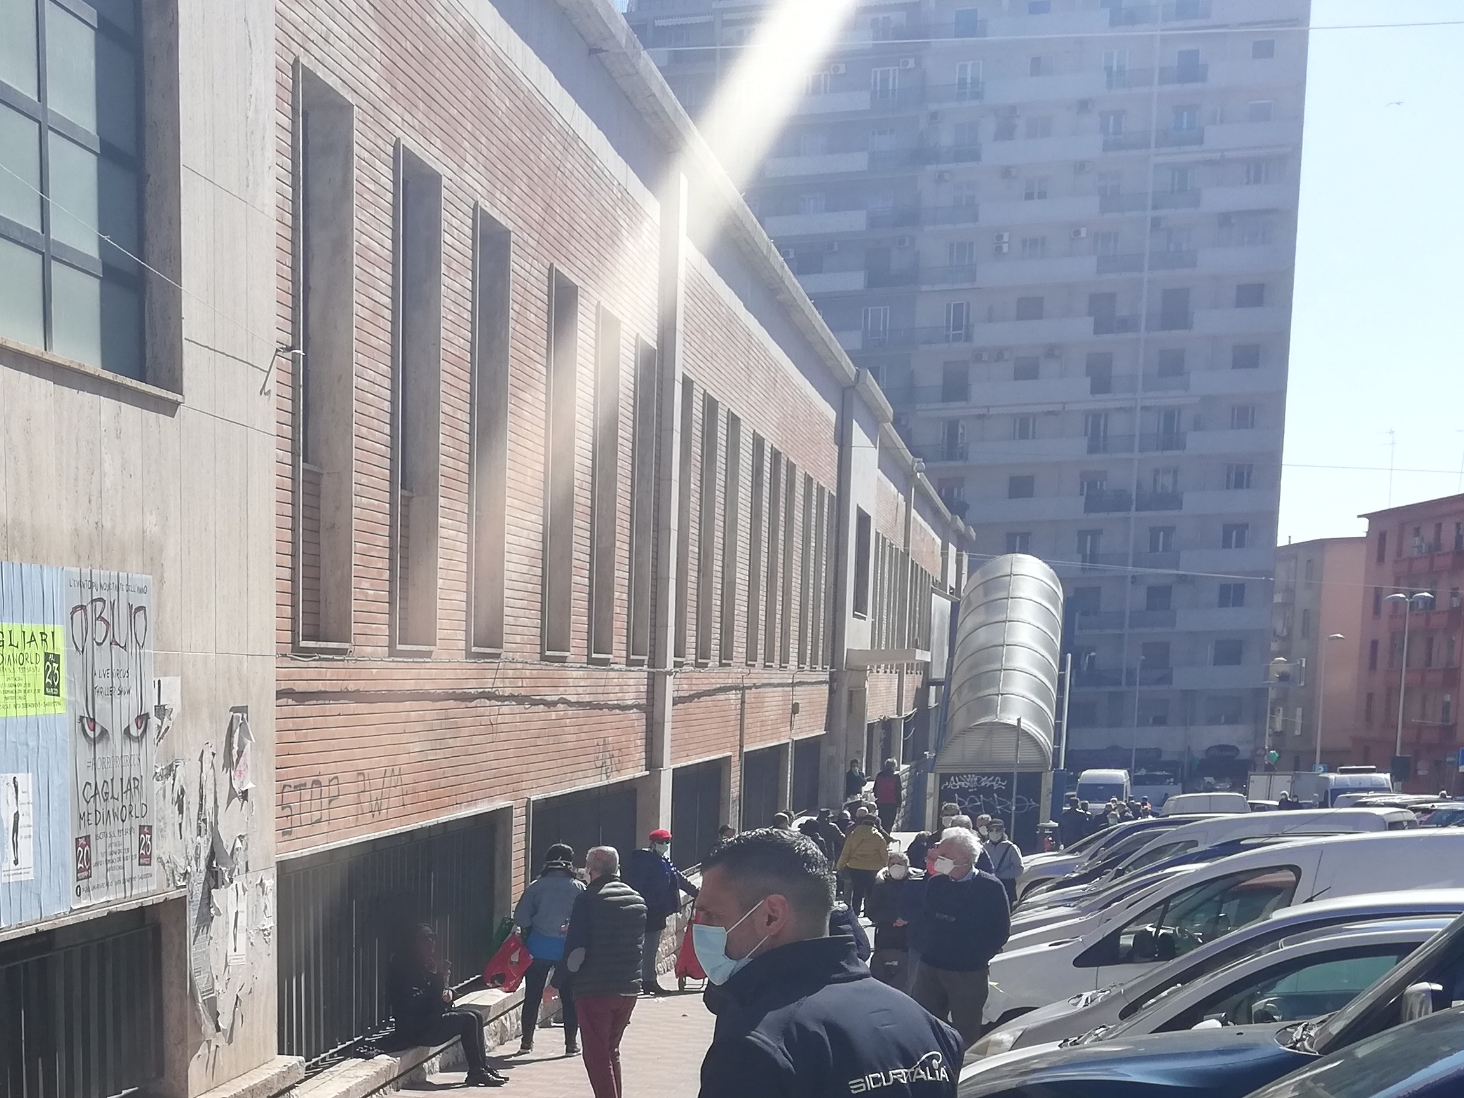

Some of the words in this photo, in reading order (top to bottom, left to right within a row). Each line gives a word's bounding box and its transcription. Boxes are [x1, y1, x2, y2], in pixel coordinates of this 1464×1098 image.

[45, 661, 59, 686] 23
[98, 669, 110, 679] LIVE
[82, 775, 143, 806] CAGLIARI
[281, 775, 340, 837] STOP
[140, 834, 152, 855] 23
[77, 847, 90, 870] 20
